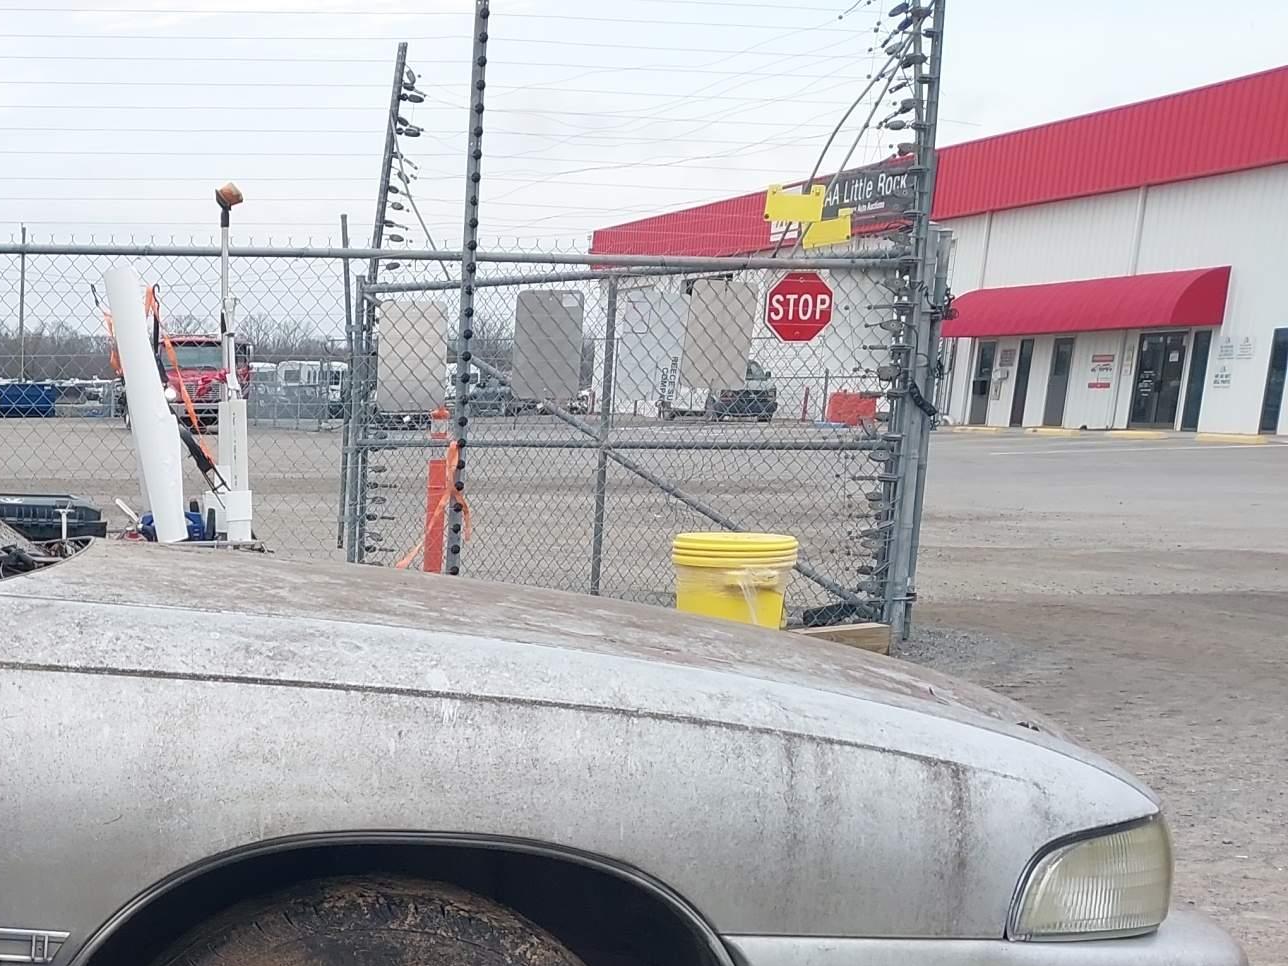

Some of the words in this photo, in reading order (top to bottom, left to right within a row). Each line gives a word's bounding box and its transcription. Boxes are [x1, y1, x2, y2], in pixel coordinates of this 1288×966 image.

[843, 177, 873, 203] Little
[877, 173, 908, 196] Rock
[770, 293, 831, 321] STOP
[668, 356, 679, 387] REECE
